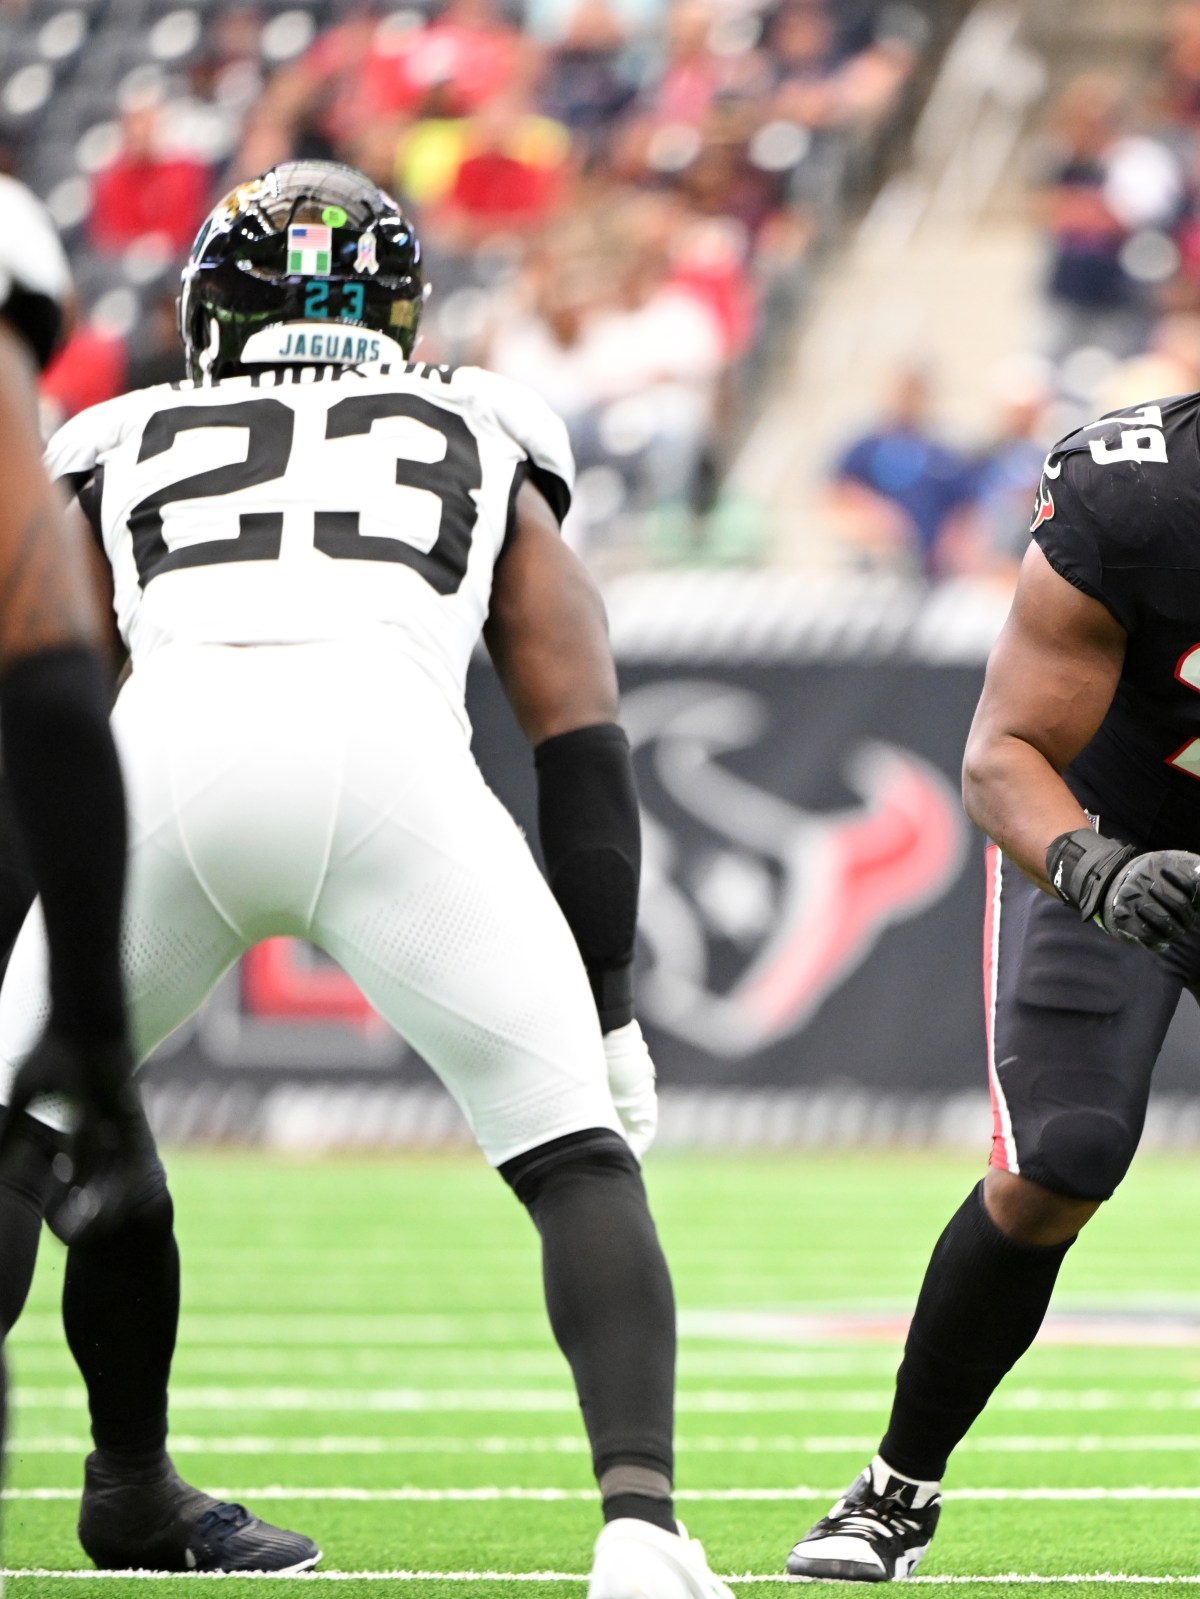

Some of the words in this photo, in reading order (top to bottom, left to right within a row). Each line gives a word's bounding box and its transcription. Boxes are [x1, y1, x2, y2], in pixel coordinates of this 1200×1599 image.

[304, 281, 365, 320] 23
[279, 334, 380, 361] JAGUARS
[127, 393, 482, 596] 23
